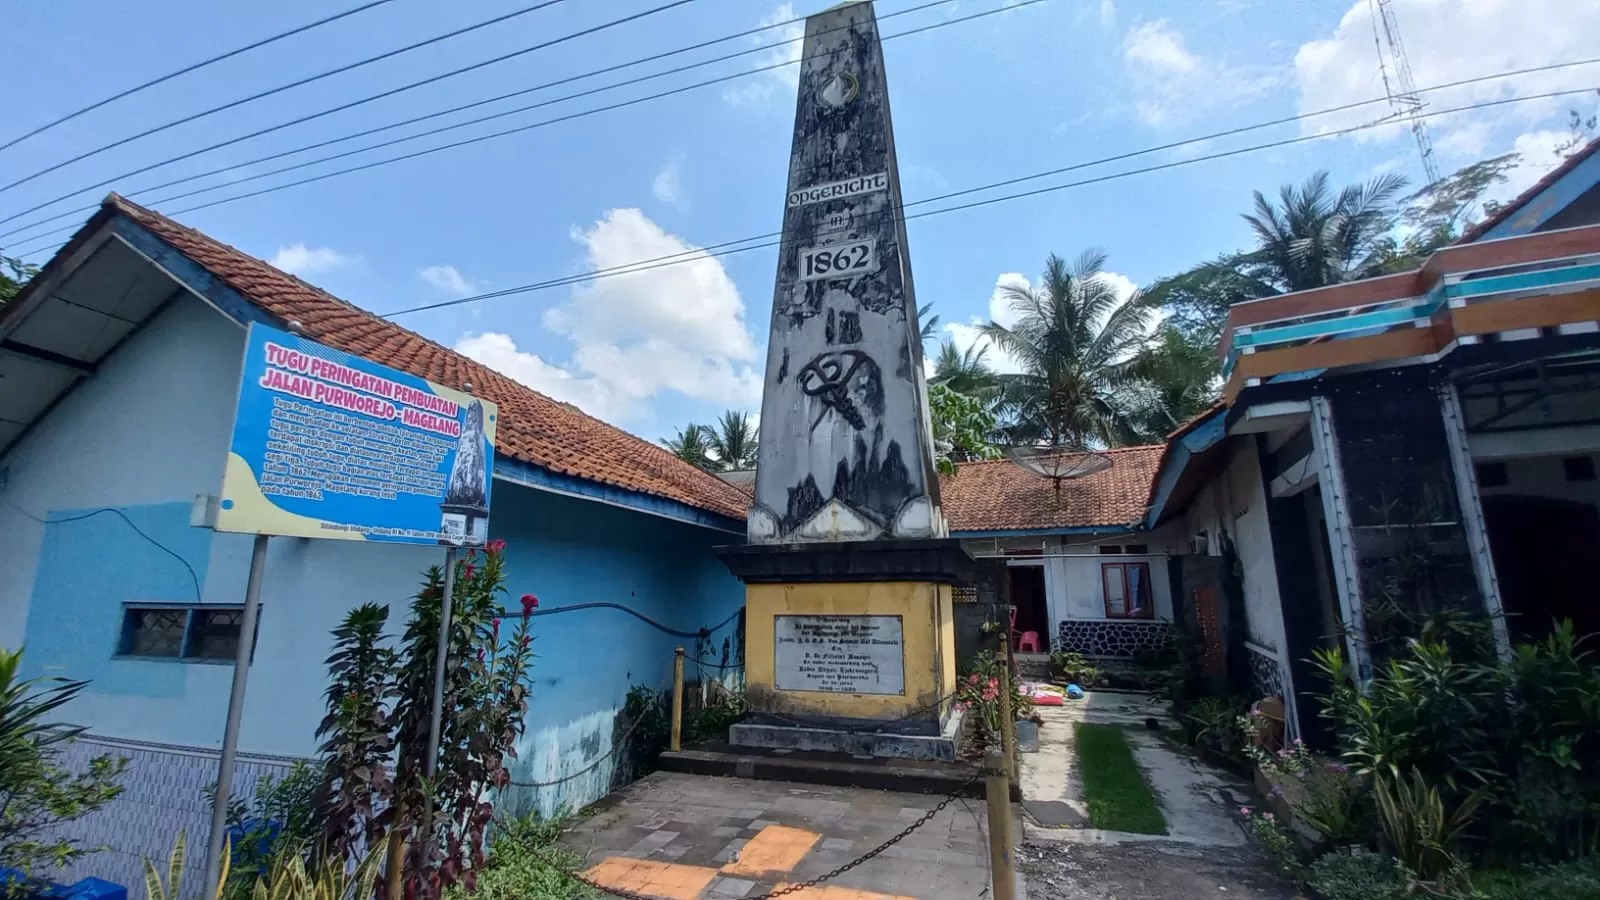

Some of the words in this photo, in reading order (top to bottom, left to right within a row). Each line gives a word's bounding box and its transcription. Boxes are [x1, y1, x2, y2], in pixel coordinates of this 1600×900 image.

[805, 245, 869, 277] 1862
[266, 344, 310, 373] TUGU
[310, 358, 393, 398] PERINGATAN
[394, 385, 457, 417] PEMBUATAN
[262, 368, 314, 398] JALAN
[314, 383, 395, 419] PURWOREJO
[404, 409, 460, 437] MAGELANG
[275, 399, 293, 411] Tugu
[293, 403, 333, 421] Peringatan
[271, 419, 289, 431] tugu
[290, 424, 319, 437] persegi
[319, 430, 345, 443] dengan
[346, 436, 365, 447] tubuh
[273, 409, 287, 419] dan
[289, 413, 330, 429] menghadap
[268, 441, 306, 456] sekeliling
[307, 449, 328, 460] tubuh
[270, 430, 302, 444] terdapat
[304, 437, 336, 450] inskripsi
[336, 444, 349, 453] dan
[381, 453, 406, 464] terdapat
[264, 463, 287, 474] tahun
[382, 482, 413, 493] peringatan
[326, 463, 342, 472] tugu
[343, 466, 365, 476] bagian
[261, 486, 280, 495] pada
[282, 489, 304, 498] tahun
